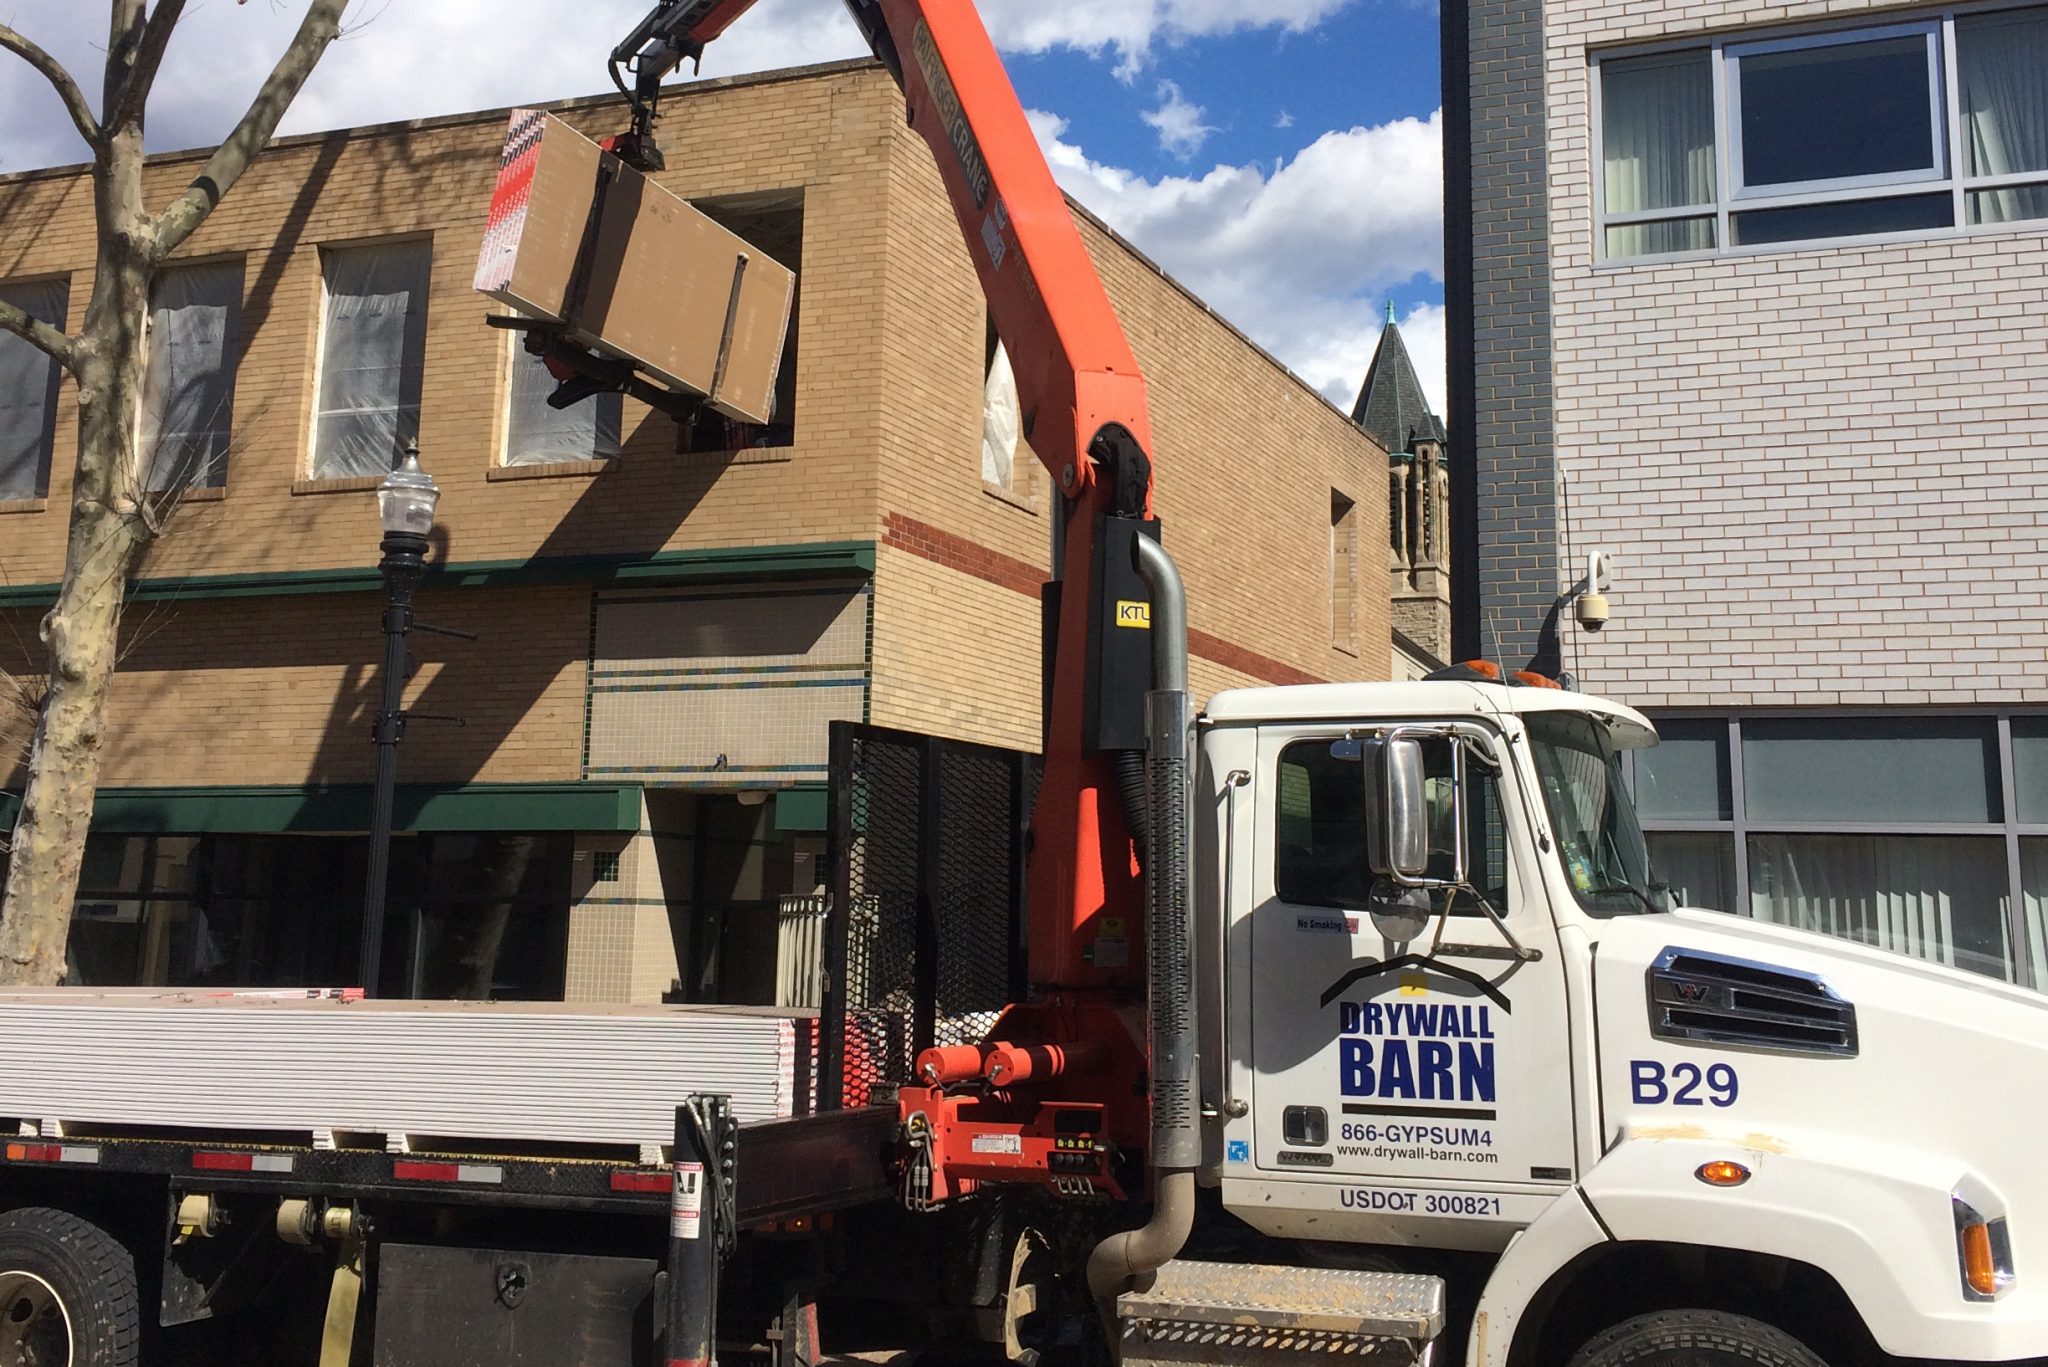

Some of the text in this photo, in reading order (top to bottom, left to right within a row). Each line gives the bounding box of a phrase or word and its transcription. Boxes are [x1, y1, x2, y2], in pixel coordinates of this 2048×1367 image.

[954, 118, 987, 203] CRANE
[1297, 920, 1342, 932] No Smoking
[1340, 1001, 1495, 1039] DRYWALL
[1339, 1037, 1496, 1103] BARN
[1630, 1060, 1739, 1107] B29
[1341, 1123, 1493, 1147] 866-GYPSUM4
[1337, 1145, 1498, 1163] www.drywall-barn.com
[1340, 1189, 1500, 1216] USDOT 300821
